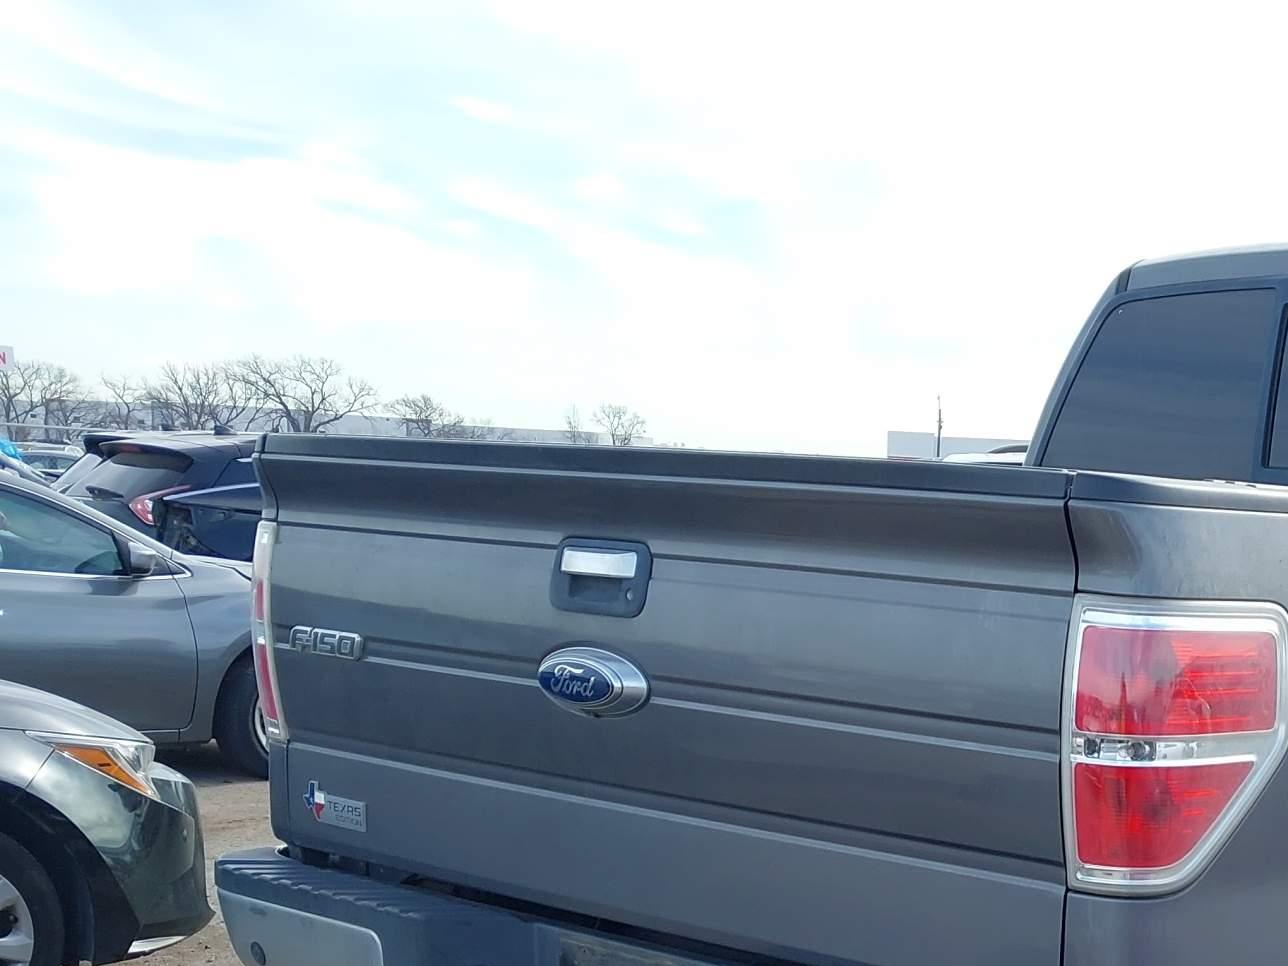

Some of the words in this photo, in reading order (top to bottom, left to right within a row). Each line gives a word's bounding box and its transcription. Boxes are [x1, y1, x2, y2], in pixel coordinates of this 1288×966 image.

[289, 625, 362, 660] F-150
[550, 664, 596, 697] Ford
[327, 800, 362, 817] TEXAS
